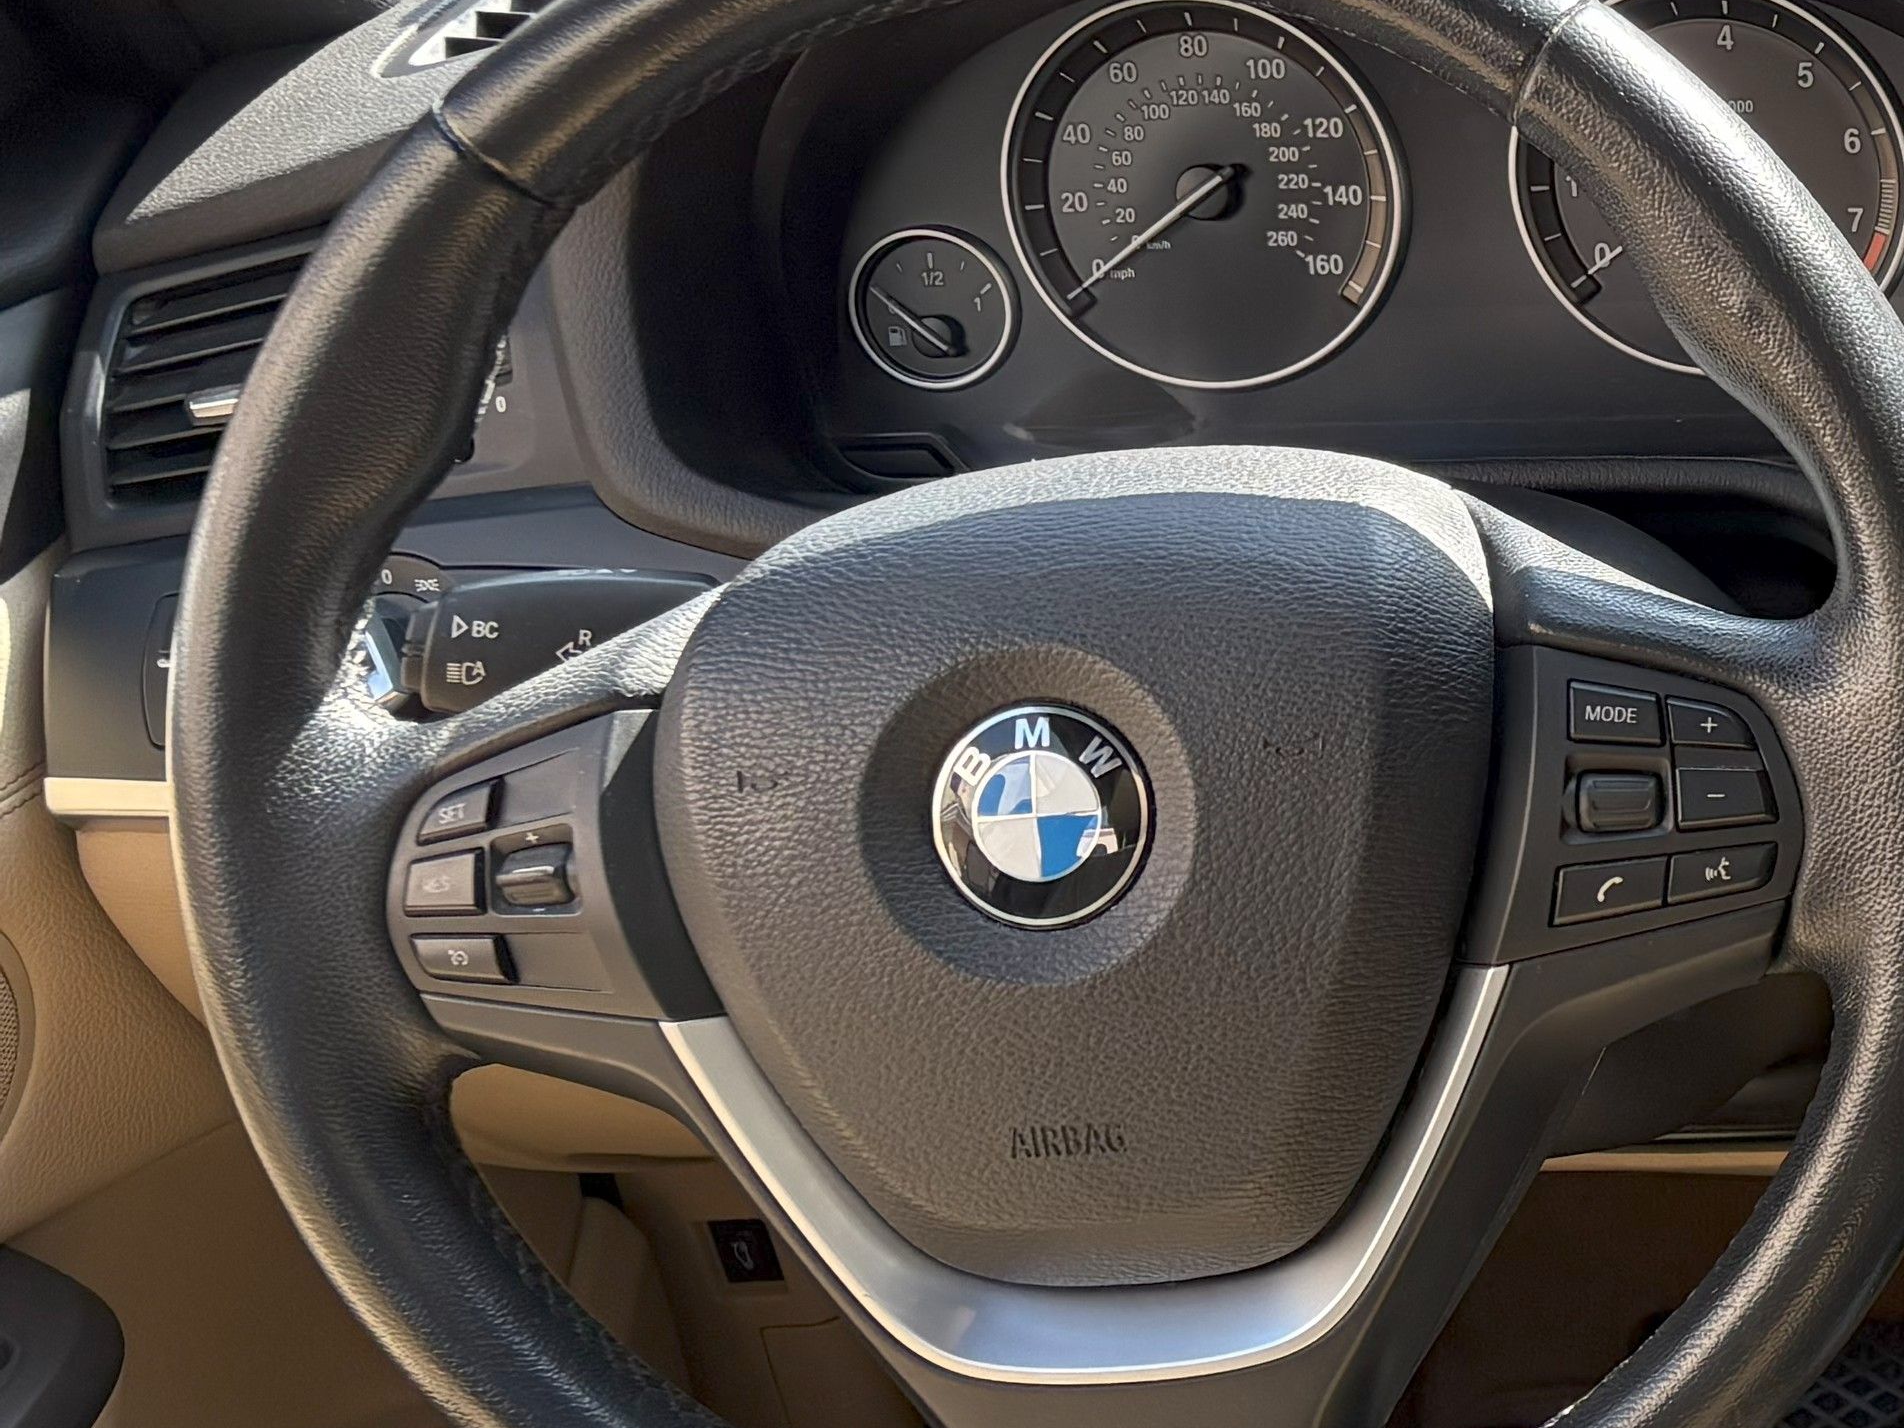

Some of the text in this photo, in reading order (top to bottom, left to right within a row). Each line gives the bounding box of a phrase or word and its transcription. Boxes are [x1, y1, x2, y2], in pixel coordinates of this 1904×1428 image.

[1179, 35, 1208, 57] 80
[1716, 25, 1734, 50] 4
[1109, 62, 1137, 83] 60
[1246, 59, 1286, 79] 100
[1797, 62, 1814, 88] 5
[1170, 90, 1198, 105] 120
[1202, 89, 1230, 104] 140
[1141, 104, 1169, 119] 100
[1233, 102, 1261, 117] 160
[1063, 124, 1090, 144] 40
[1124, 126, 1144, 141] 80
[1253, 122, 1281, 138] 180
[1303, 117, 1344, 138] 120
[1843, 128, 1861, 154] 6
[1112, 151, 1132, 165] 60
[1269, 146, 1299, 162] 200
[1107, 178, 1127, 193] 40
[1278, 174, 1309, 189] 220
[1061, 192, 1088, 212] 20
[1323, 185, 1362, 206] 140
[1115, 208, 1136, 223] 20
[1278, 204, 1308, 219] 240
[1847, 207, 1863, 232] 7
[1267, 231, 1298, 246] 260
[1110, 268, 1135, 280] mph
[1305, 254, 1344, 275] 160
[921, 271, 944, 286] 1/2
[471, 620, 499, 639] BC
[578, 629, 592, 647] R
[1585, 705, 1638, 724] MODE
[953, 716, 1122, 787] BMW
[439, 803, 466, 825] SET
[1010, 1123, 1126, 1160] AIRBAG
